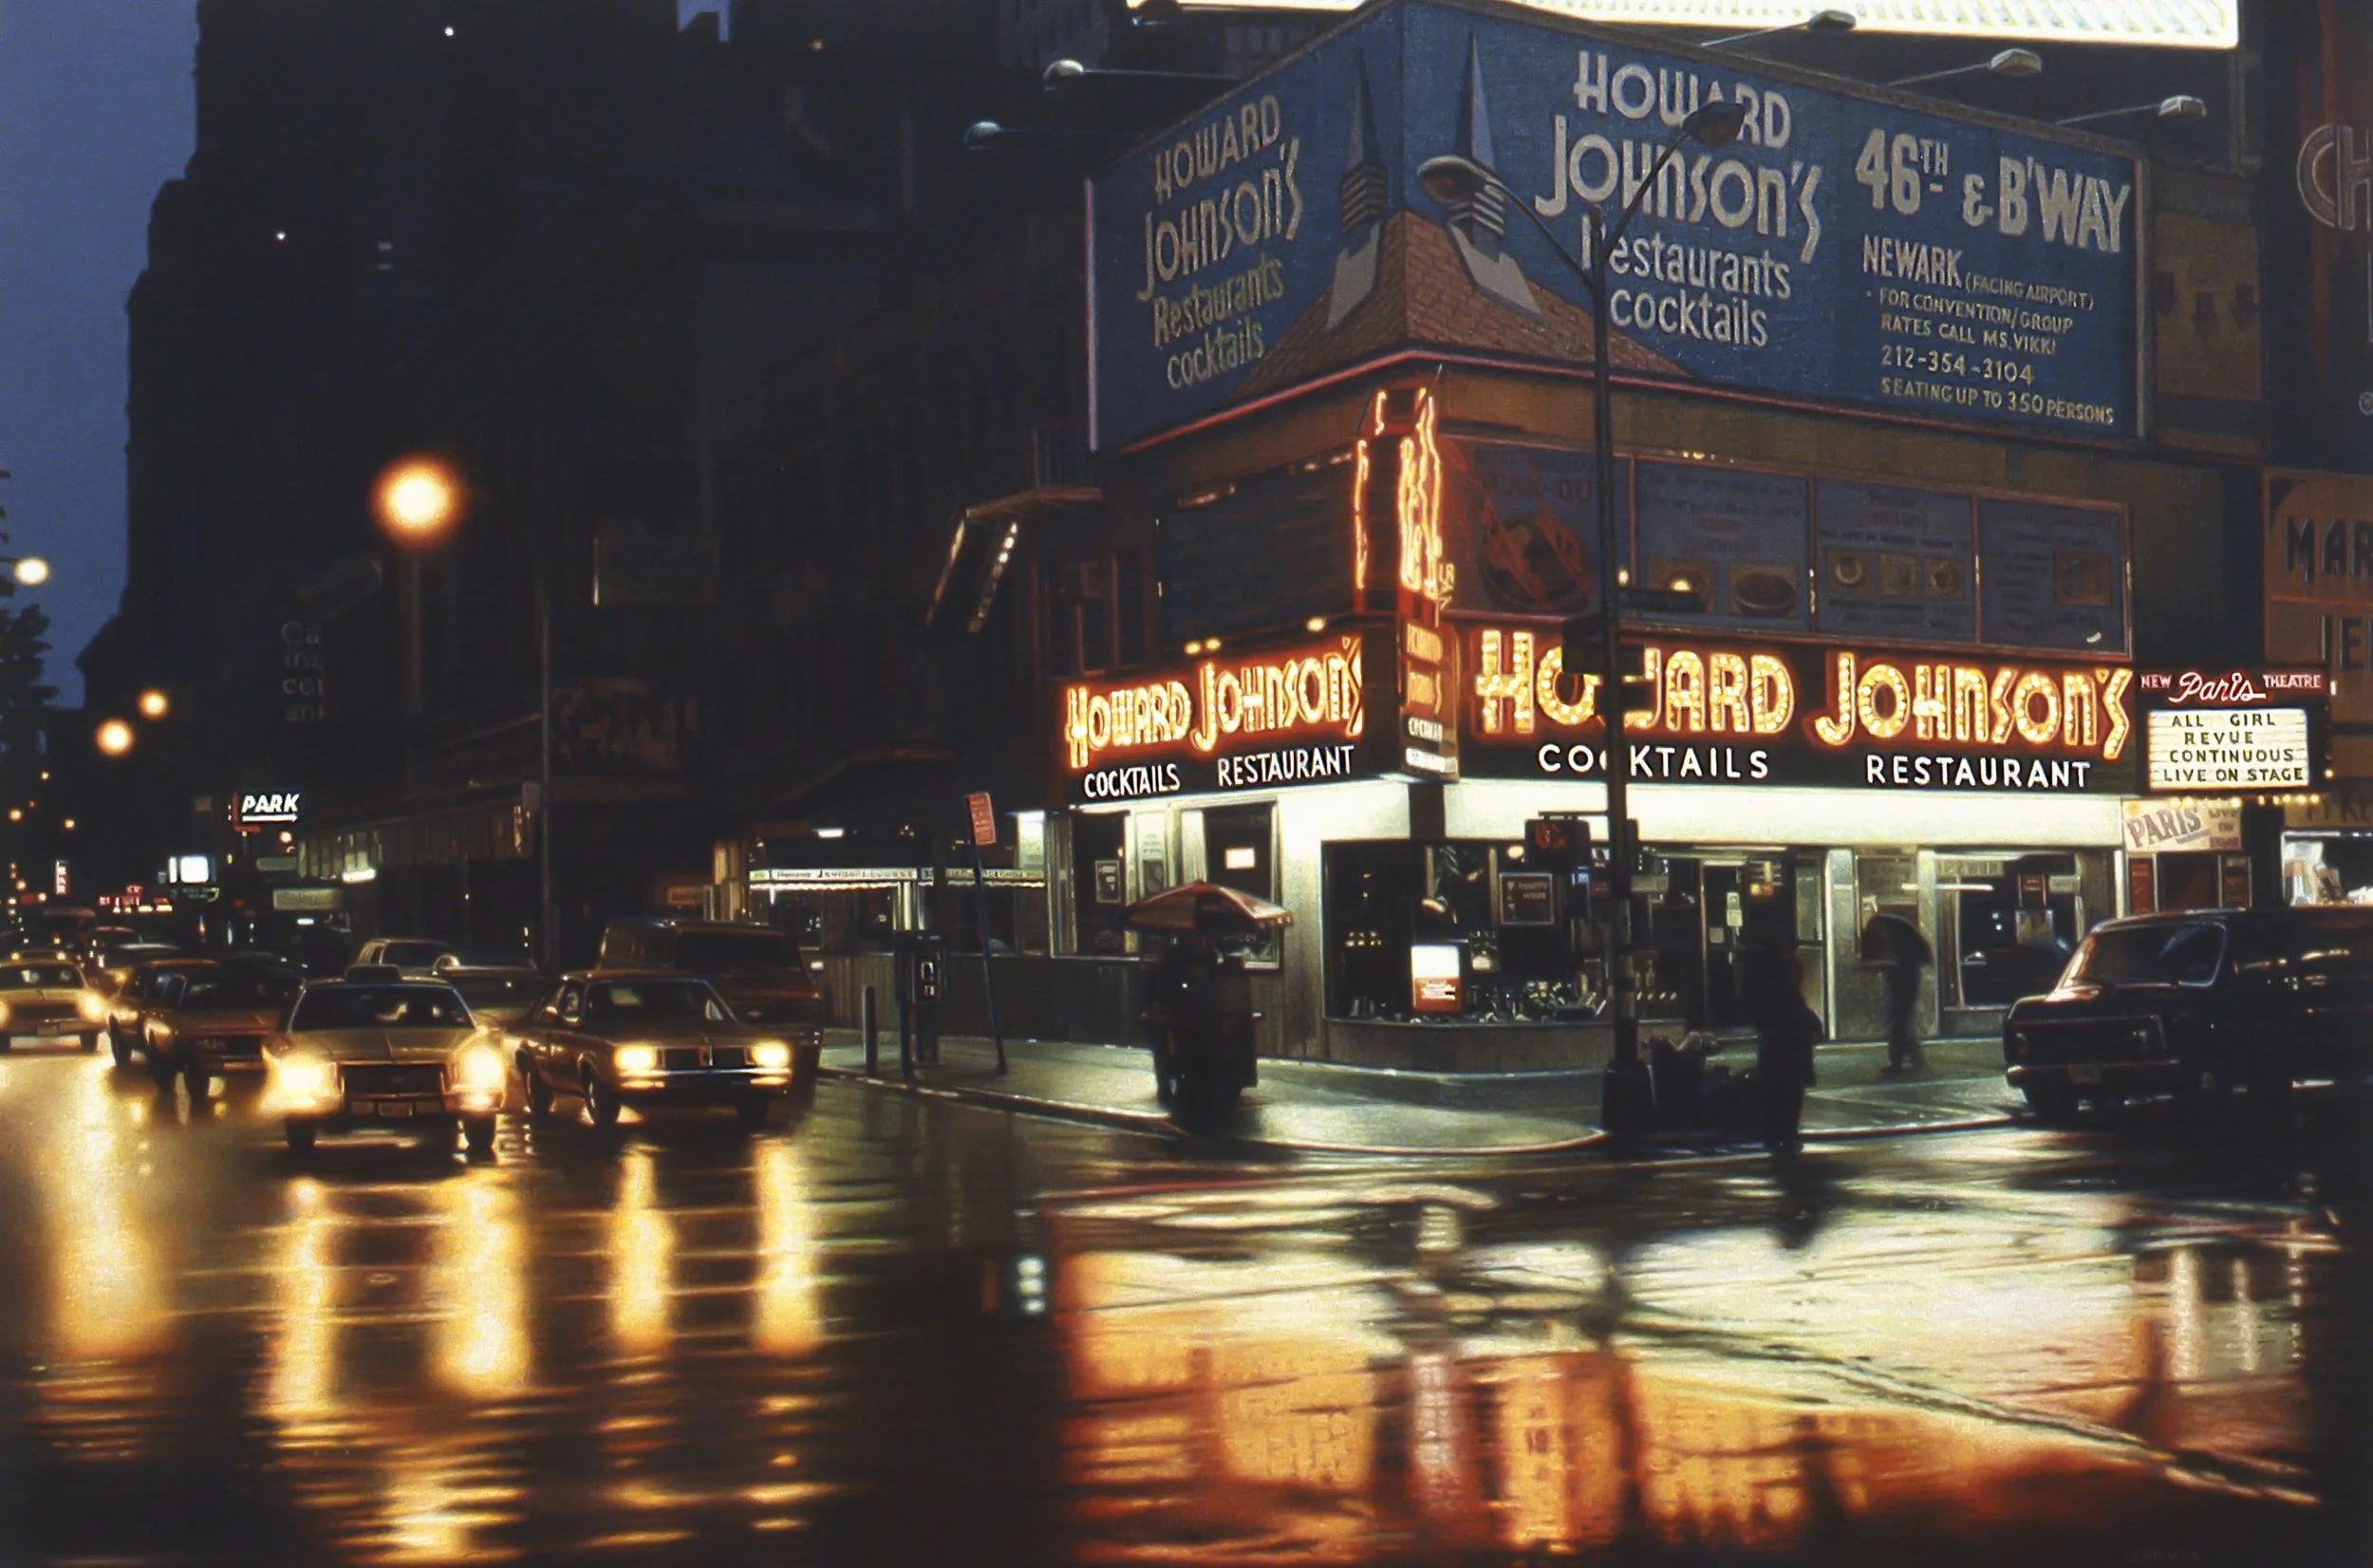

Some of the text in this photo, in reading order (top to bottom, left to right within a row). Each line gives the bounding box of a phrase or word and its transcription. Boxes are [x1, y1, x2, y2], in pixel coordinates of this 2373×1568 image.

[1154, 95, 1280, 204] HOWARD
[1535, 114, 1823, 265] JOHNSON'S
[1962, 174, 1993, 228] &
[1999, 155, 2131, 252] B'WAY
[1136, 137, 1303, 302] JOHNSON'S
[1862, 233, 2094, 311] NEWARK (FACING AIRPORT)
[1153, 251, 1284, 347] Restaurants
[1610, 288, 1768, 347] cocktails
[1879, 288, 1910, 309] FOR
[1167, 315, 1265, 390] cocktails
[1880, 313, 1933, 337] RATES
[1938, 322, 1975, 345] CALL
[1879, 377, 2116, 426] SEATING UP TO 350 PERSONS
[1065, 686, 1192, 768] HOWARD
[1189, 636, 1362, 752] JOHNSON'S
[1814, 651, 2133, 760] JOHNSON'S
[2140, 671, 2322, 703] NEW Paris THEATRE
[2172, 713, 2277, 728] ALL GIRL
[2184, 731, 2254, 745] REVUE
[1084, 745, 1355, 798] COCKTAILS RESTAURANT
[1866, 755, 2092, 789] RESTAURANT
[2163, 767, 2304, 783] LIVE ON STAGE
[2170, 748, 2295, 763] CONTINUOUS
[241, 793, 301, 813] PARK
[2126, 807, 2202, 848] PARIS
